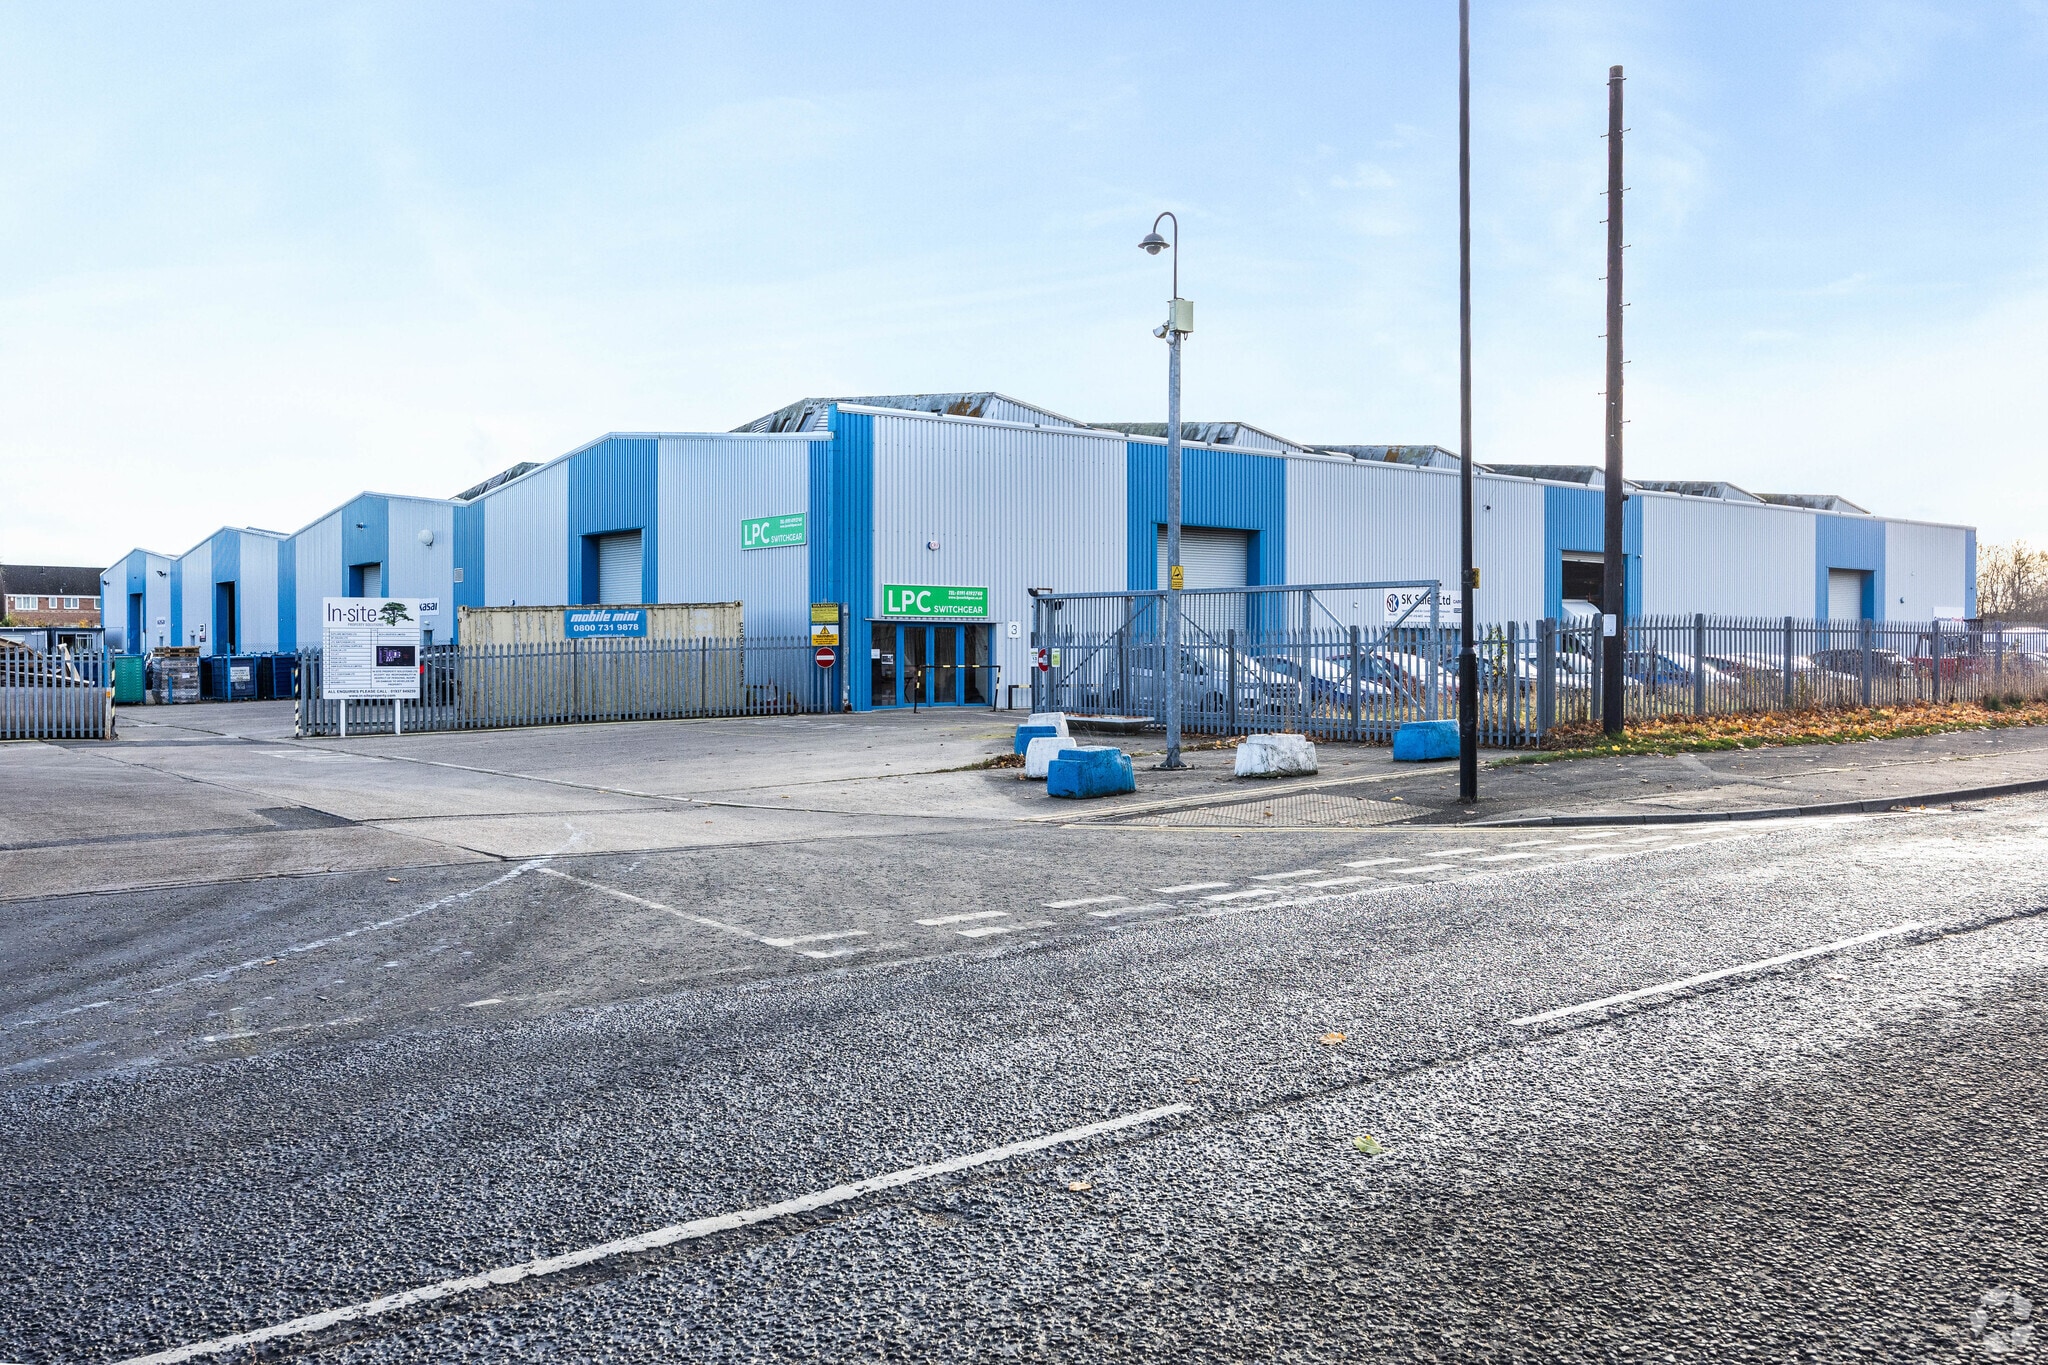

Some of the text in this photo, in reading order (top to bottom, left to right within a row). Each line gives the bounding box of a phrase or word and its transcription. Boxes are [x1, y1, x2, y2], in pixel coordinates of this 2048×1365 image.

[744, 521, 803, 546] LPC SWITCHGEAR
[888, 590, 931, 613] LPC
[1401, 593, 1412, 605] SK
[327, 603, 377, 622] In-site
[933, 605, 983, 614] SWITCHGEAR
[571, 610, 640, 622] mobile mini
[573, 624, 596, 632] 0800
[617, 623, 639, 631] 9878
[1011, 624, 1018, 635] 3
